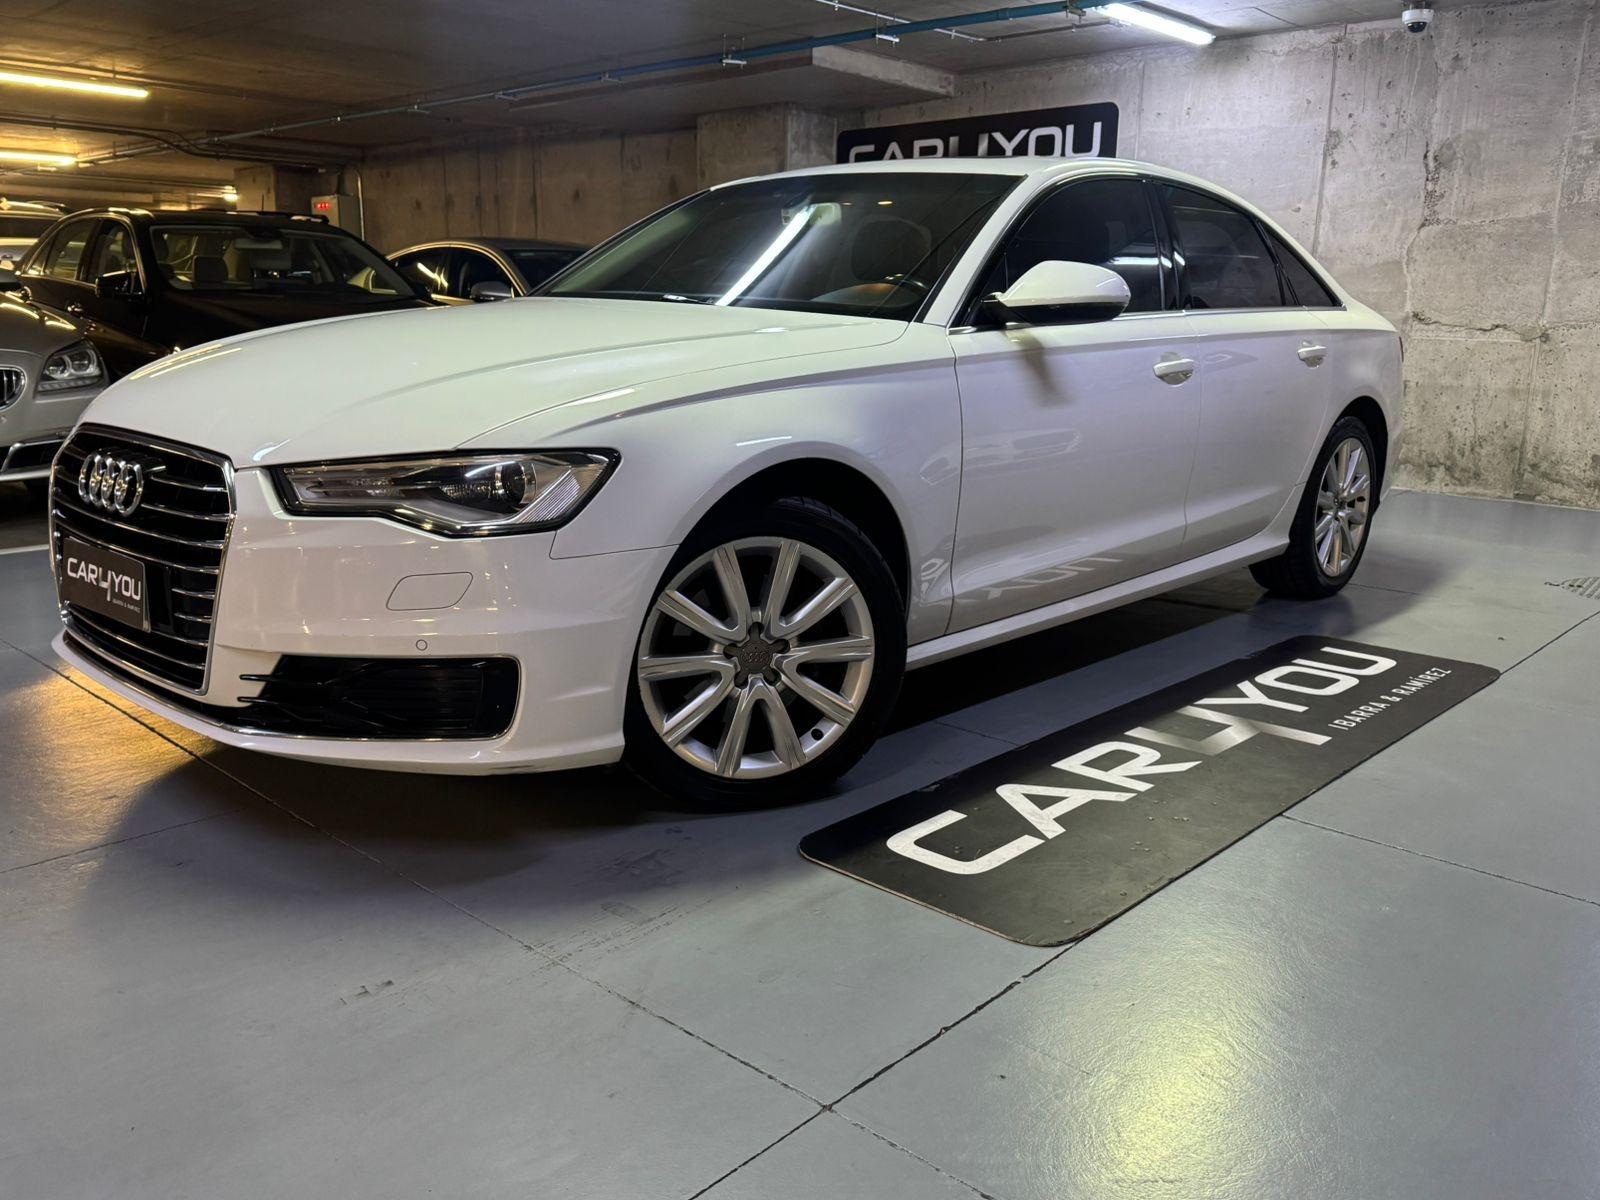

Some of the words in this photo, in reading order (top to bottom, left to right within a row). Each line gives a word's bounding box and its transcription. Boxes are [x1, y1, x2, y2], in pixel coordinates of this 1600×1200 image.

[67, 557, 141, 601] CAR4YOU
[1328, 701, 1390, 730] IBARRA
[887, 646, 1397, 874] CAR4YOU
